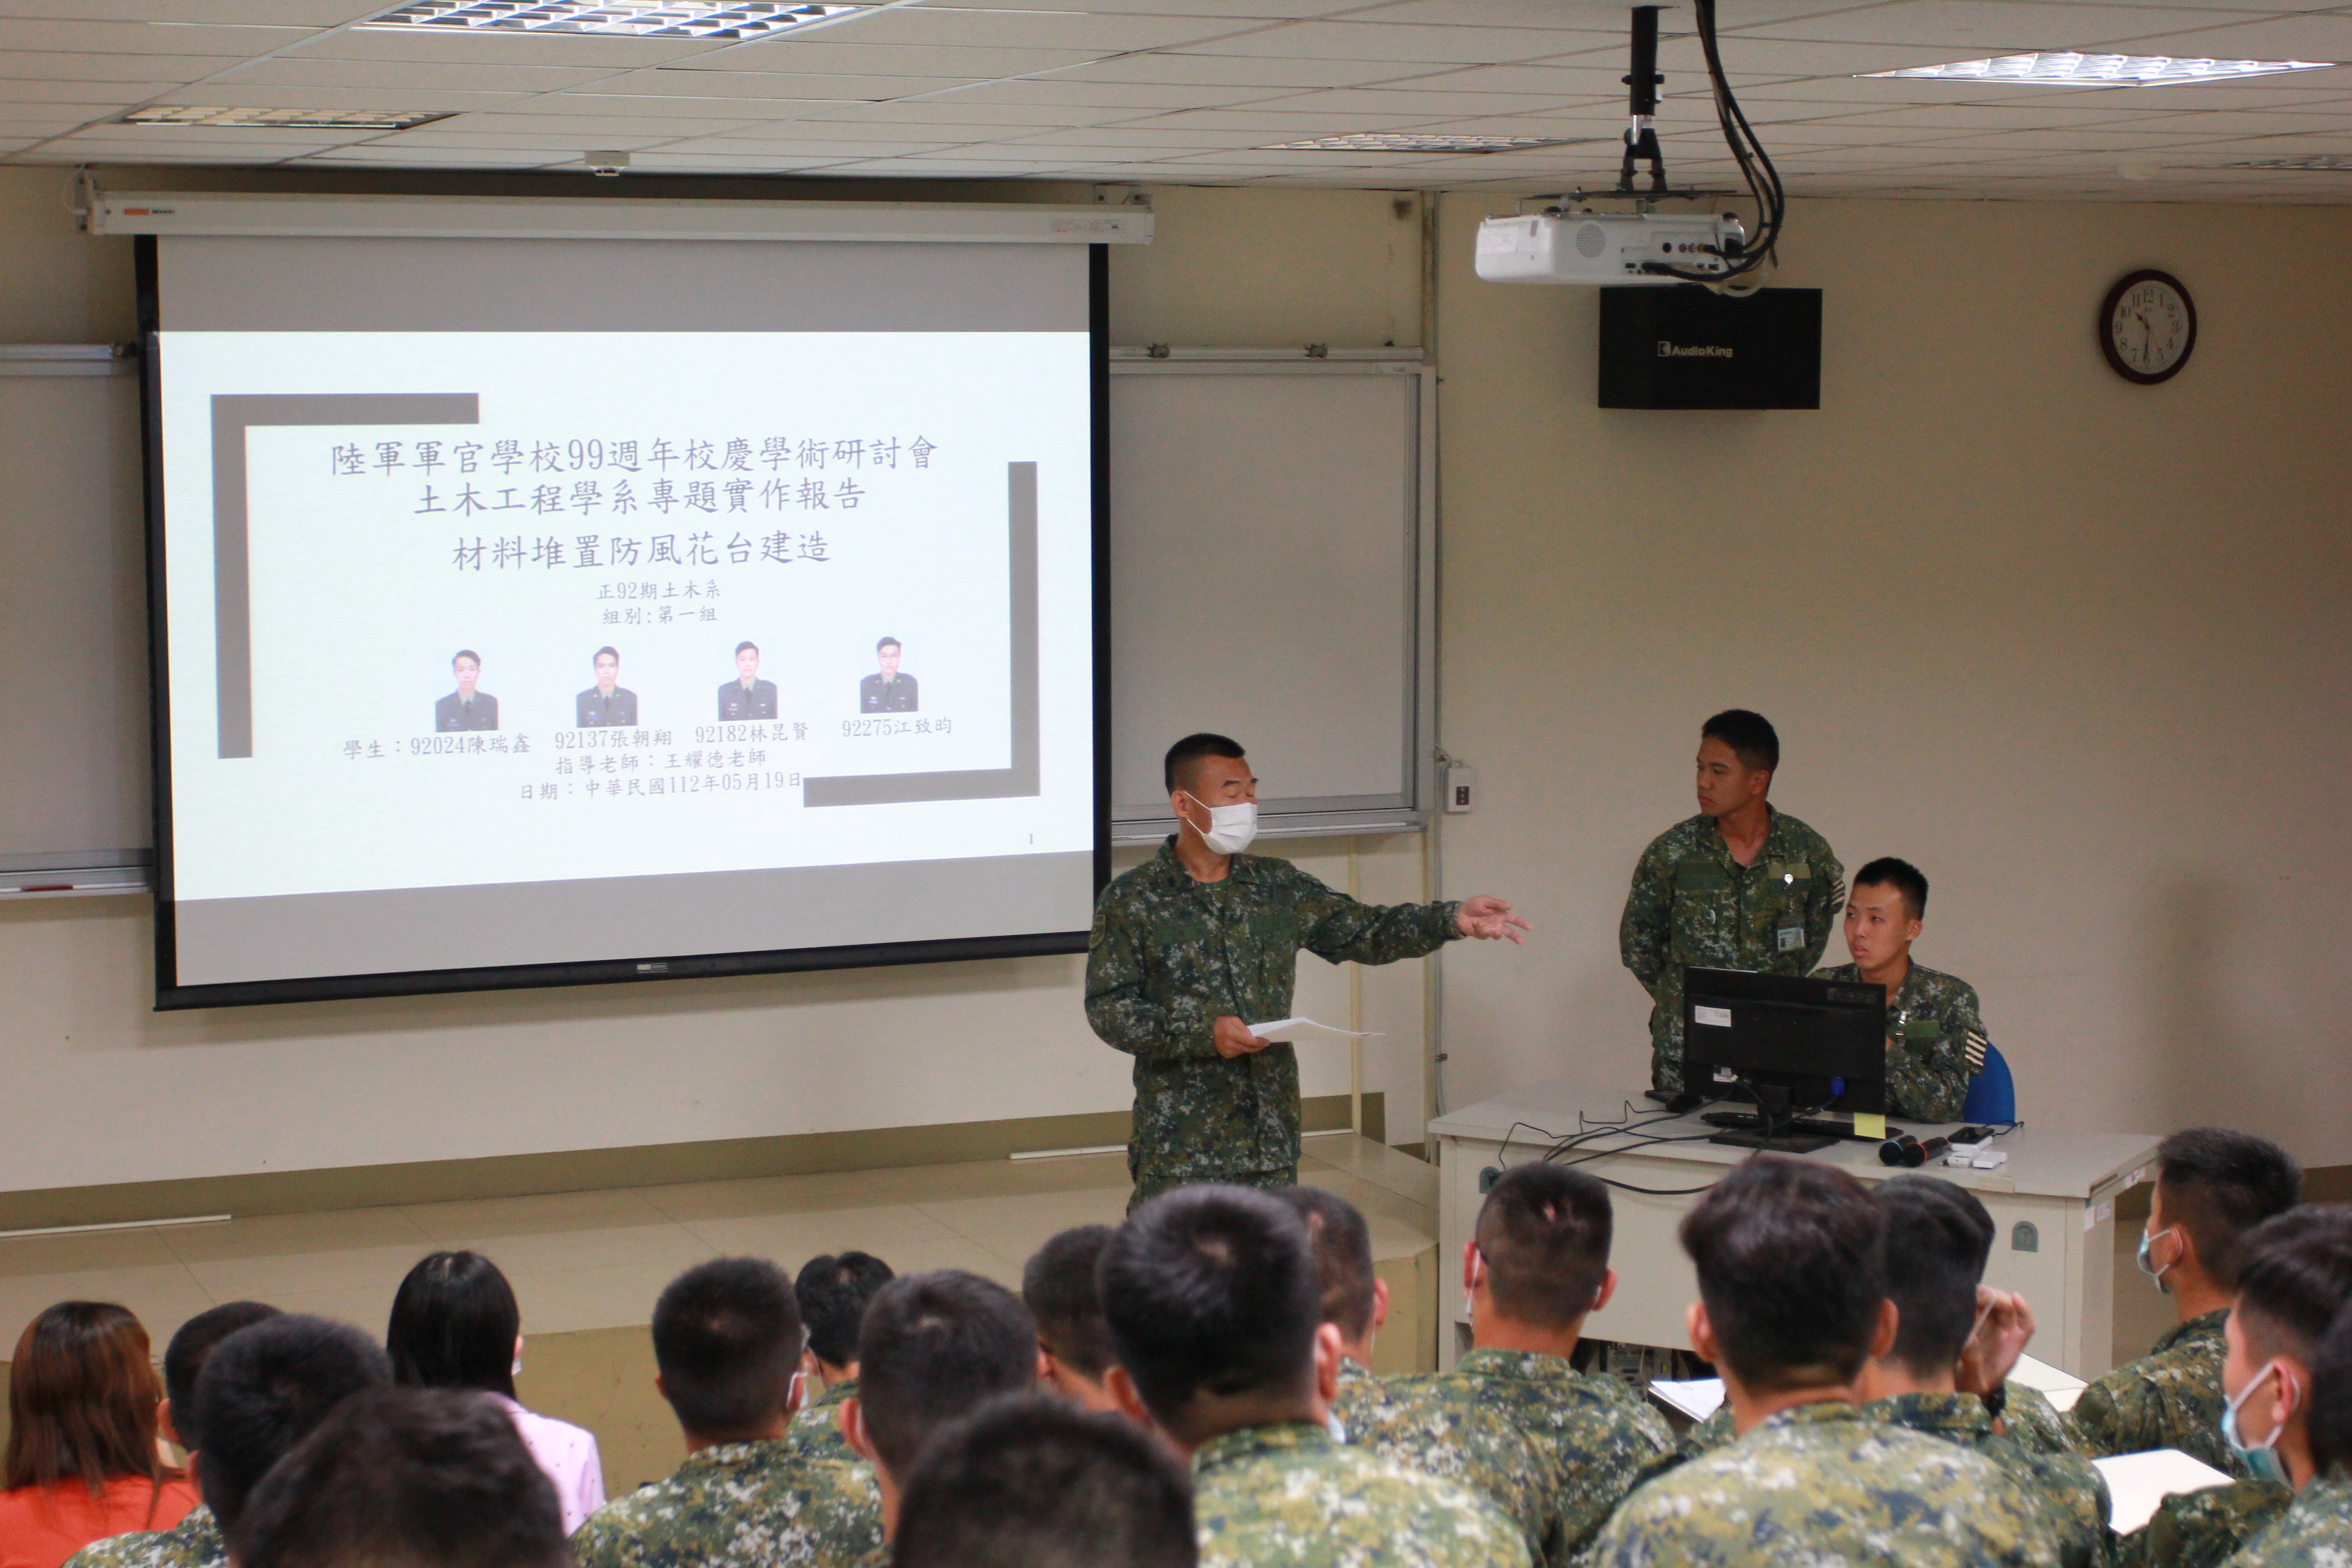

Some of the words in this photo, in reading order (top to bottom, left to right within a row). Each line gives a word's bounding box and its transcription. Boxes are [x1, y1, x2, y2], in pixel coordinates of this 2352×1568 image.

[2115, 321, 2122, 335] 9
[1671, 346, 1733, 357] AudioKing
[331, 435, 939, 476] 陸軍軍官學校99週年校慶學術研討會
[413, 476, 867, 517] 土木工程學系專題實作報告
[452, 529, 832, 572] 材料堆置防風花台建造
[596, 579, 721, 601] 正92期土木系
[695, 722, 808, 744] 92182林昆賢
[1028, 833, 1034, 845] 1
